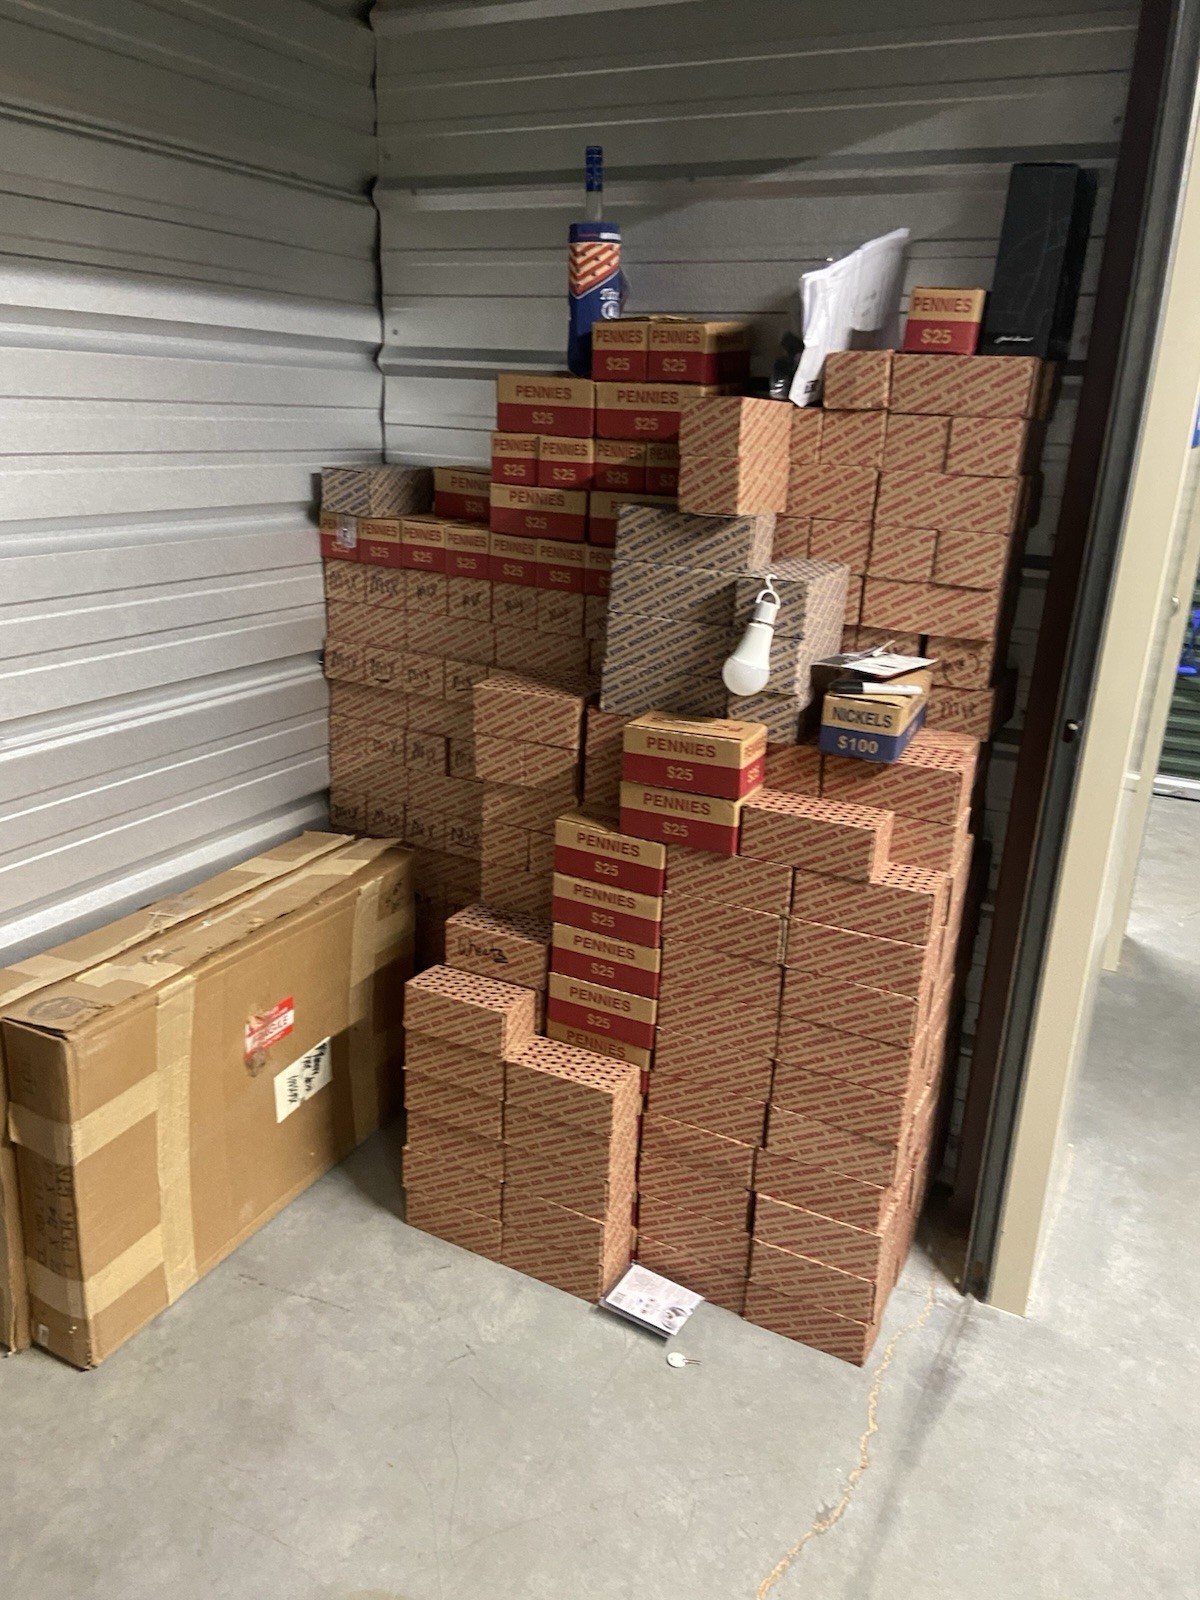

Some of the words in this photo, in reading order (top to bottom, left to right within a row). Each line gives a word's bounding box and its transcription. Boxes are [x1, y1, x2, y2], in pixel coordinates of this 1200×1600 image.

[912, 296, 973, 313] PENNIES
[596, 330, 643, 344] PENNIES
[652, 330, 700, 344] PENNIES
[920, 328, 953, 344] $25
[606, 357, 631, 371] $25
[662, 358, 687, 372] $25
[516, 385, 572, 400] PENNIES
[617, 389, 680, 405] PENNIES
[532, 412, 554, 425] $25
[634, 417, 658, 431] $25
[493, 438, 536, 452] PENNIES
[542, 442, 588, 457] PENNIES
[599, 444, 642, 460] PENNIES
[503, 463, 526, 477] $25
[553, 468, 577, 482] $25
[606, 471, 629, 485] $25
[509, 490, 565, 507] PENNIES
[362, 523, 398, 536] PENNIES
[525, 516, 547, 530] $25
[404, 527, 441, 542] PENNIES
[448, 532, 487, 548] PENNIES
[370, 546, 389, 559] $25
[494, 539, 534, 556] PENNIES
[540, 545, 582, 562] PENNIES
[412, 551, 433, 564] $25
[457, 556, 477, 570] $25
[503, 563, 523, 577] $25
[550, 570, 571, 584] $25
[832, 706, 893, 728] NICKELS
[646, 736, 716, 758] PENNIES
[837, 735, 879, 754] $100
[666, 766, 693, 782] $25
[643, 792, 711, 815] PENNIES
[662, 821, 689, 838] $25
[577, 832, 640, 857] PENNIES
[594, 861, 619, 877] $25
[573, 883, 636, 909] PENNIES
[591, 911, 615, 928] $25
[573, 935, 635, 960] PENNIES
[590, 962, 615, 979] $25
[569, 986, 631, 1012] PENNIES
[586, 1013, 611, 1030] $25
[566, 1030, 626, 1059] PENNIES
